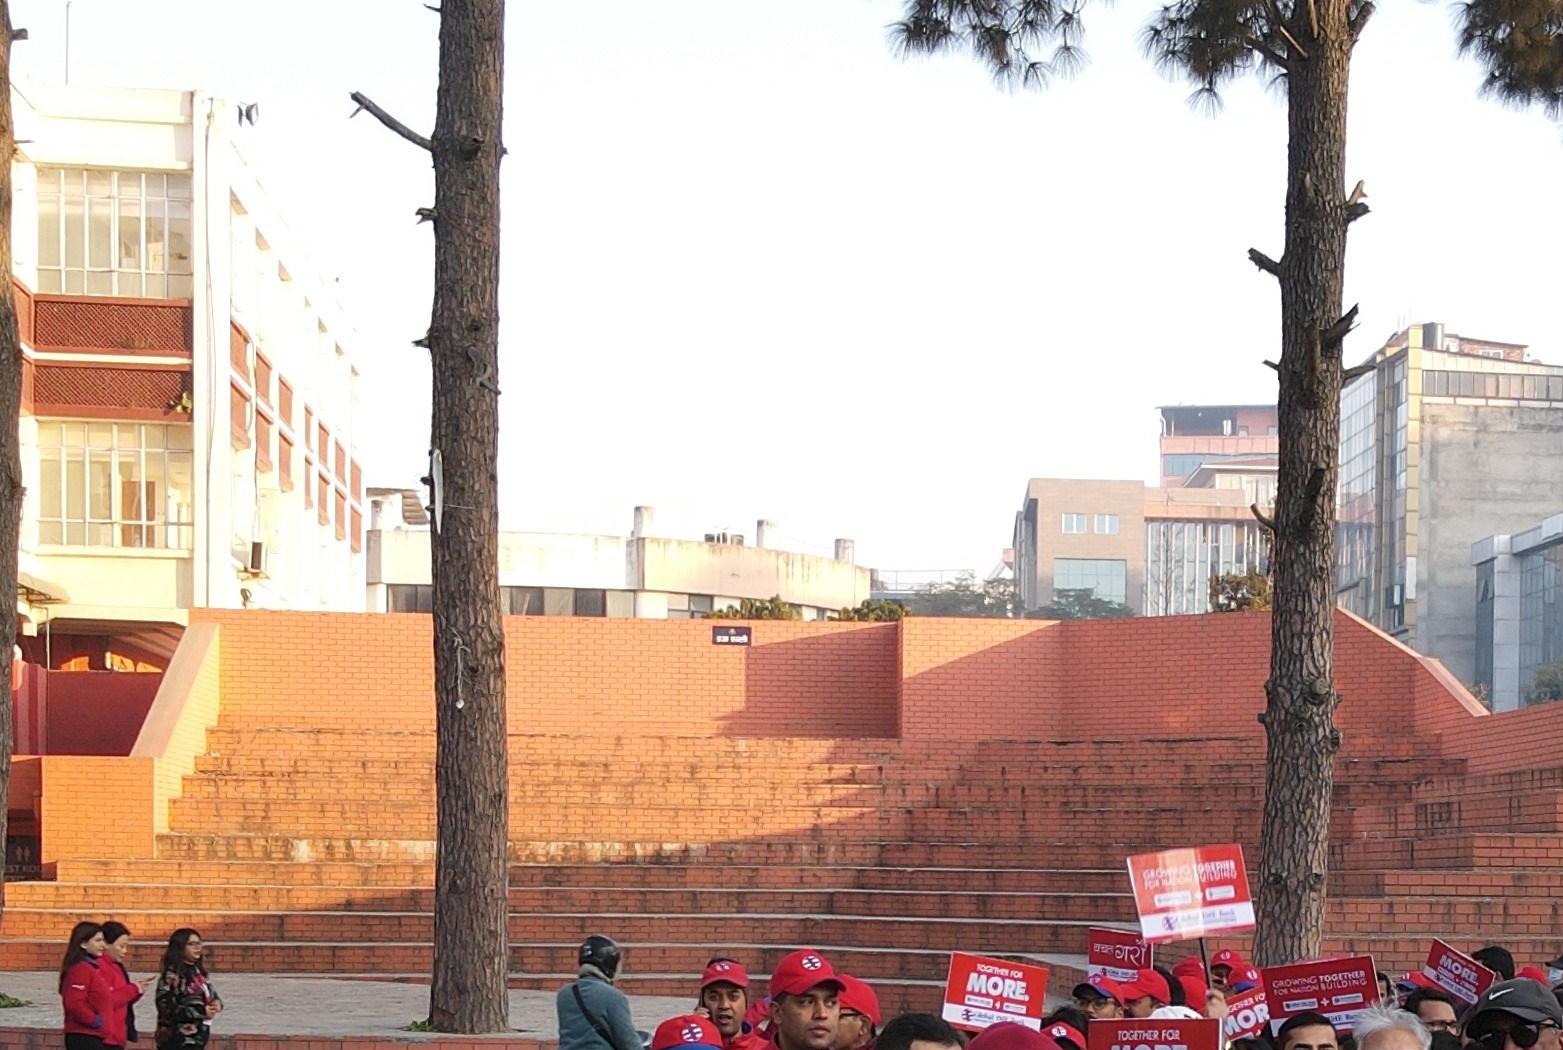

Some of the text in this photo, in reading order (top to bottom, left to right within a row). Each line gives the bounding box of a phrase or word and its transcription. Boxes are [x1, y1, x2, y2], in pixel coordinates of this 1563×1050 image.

[966, 972, 1030, 1002] MORE.
[1272, 970, 1366, 989] GROWING TOGETHER
[1272, 988, 1289, 997] FOR
[1320, 978, 1368, 991] BUILDING
[1224, 1003, 1270, 1036] MOR
[1118, 1030, 1180, 1040] TOGETHER FOR
